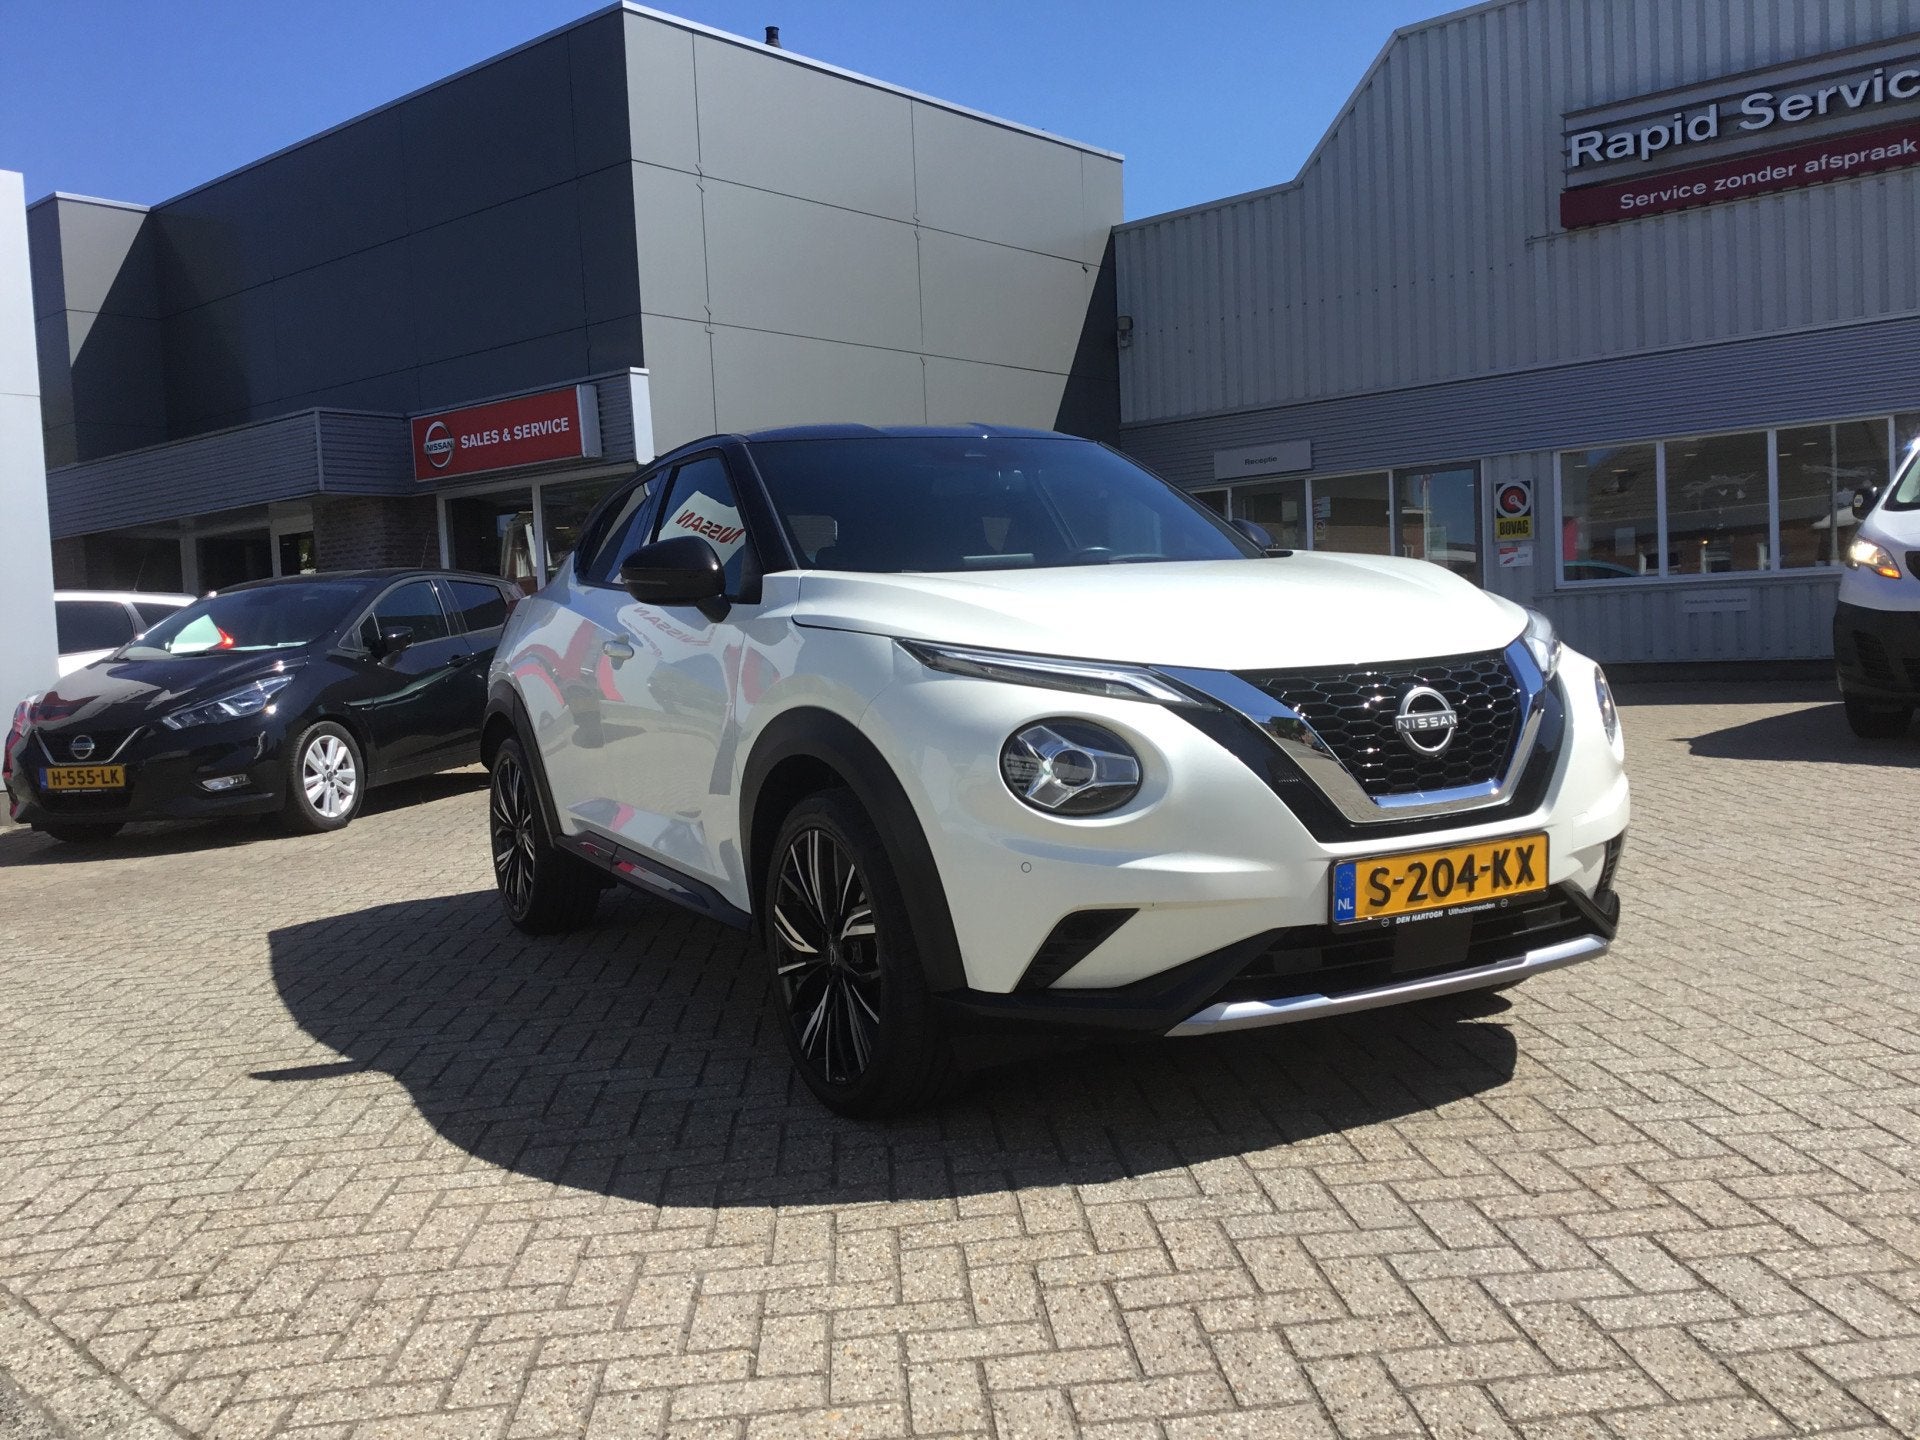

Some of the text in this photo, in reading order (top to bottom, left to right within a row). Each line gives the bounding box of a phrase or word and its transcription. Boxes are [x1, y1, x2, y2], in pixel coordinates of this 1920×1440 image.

[1571, 103, 1718, 167] Rapid
[1620, 138, 1917, 210] Service zonder afspraak
[460, 417, 569, 449] SALES & SERVICE
[426, 440, 453, 452] NISSAN
[1397, 714, 1458, 731] NISSAN
[51, 769, 120, 786] H-555-LK
[1368, 844, 1536, 907] S-204-KX
[1337, 898, 1354, 911] NL
[1396, 915, 1411, 924] DEN
[1412, 910, 1444, 922] HARTOGH
